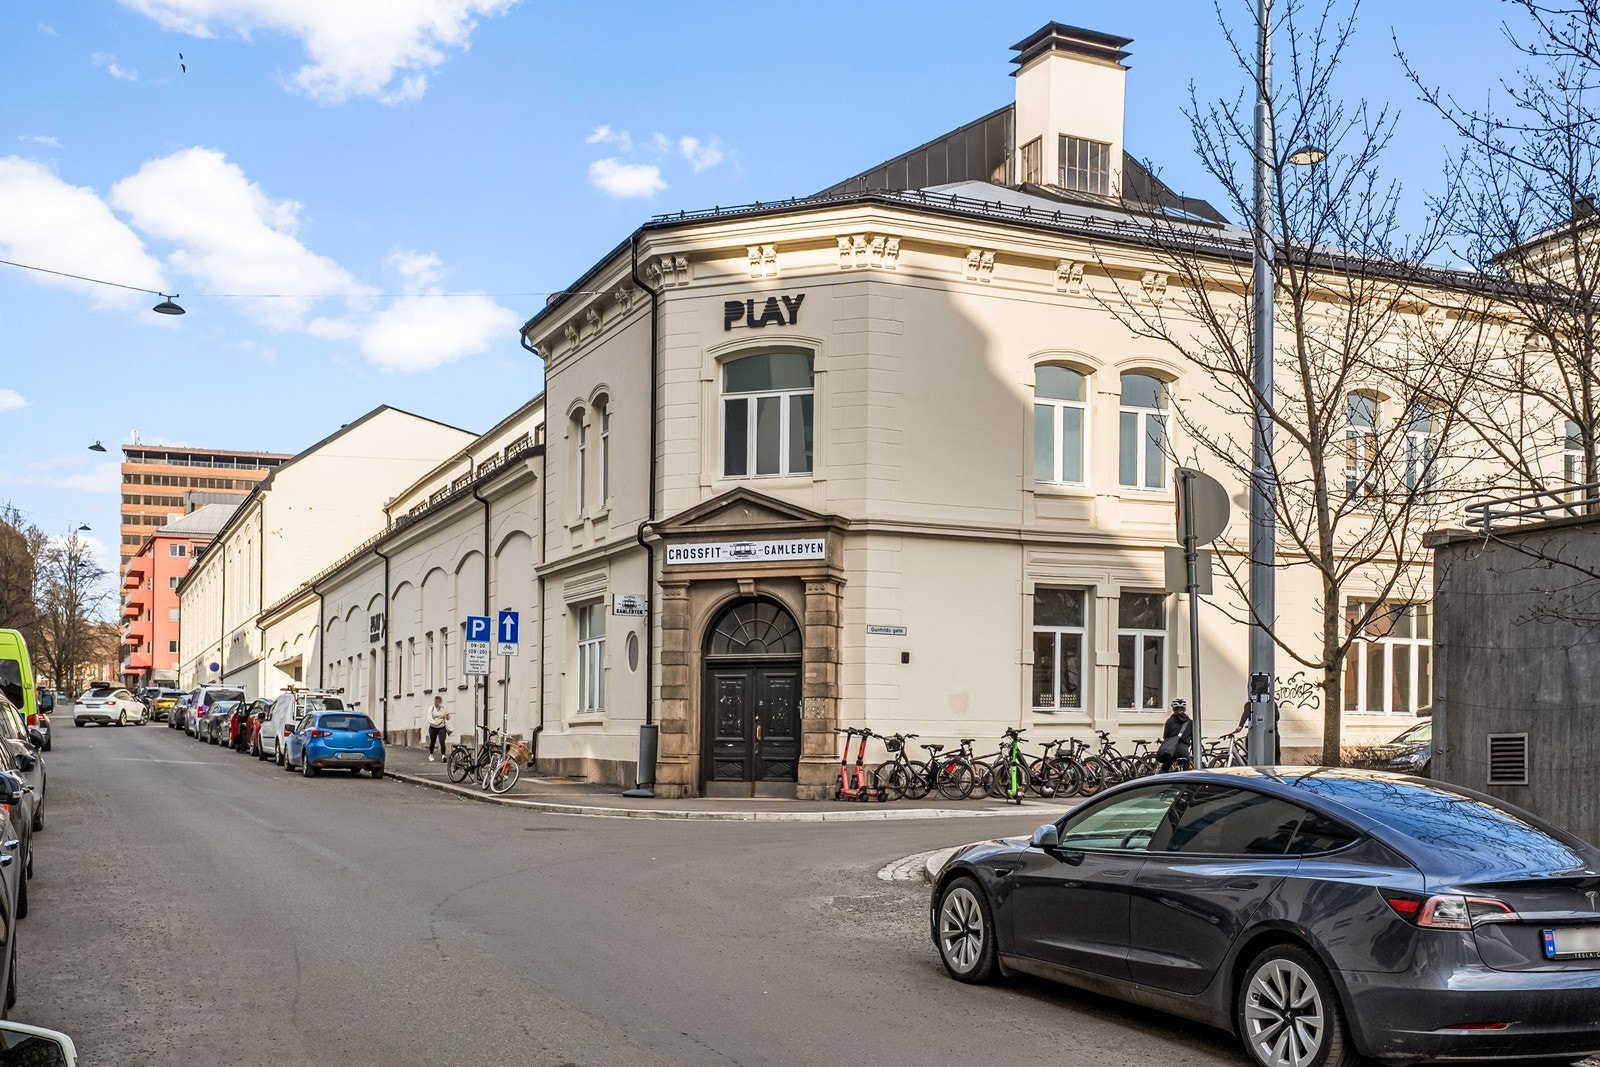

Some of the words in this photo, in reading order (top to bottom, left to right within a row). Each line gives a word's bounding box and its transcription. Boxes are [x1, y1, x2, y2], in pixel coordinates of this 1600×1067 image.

[725, 294, 805, 331] PLAY
[668, 547, 721, 560] CROSSFIT
[764, 543, 823, 555] GAMLEBYEN
[472, 619, 485, 638] P
